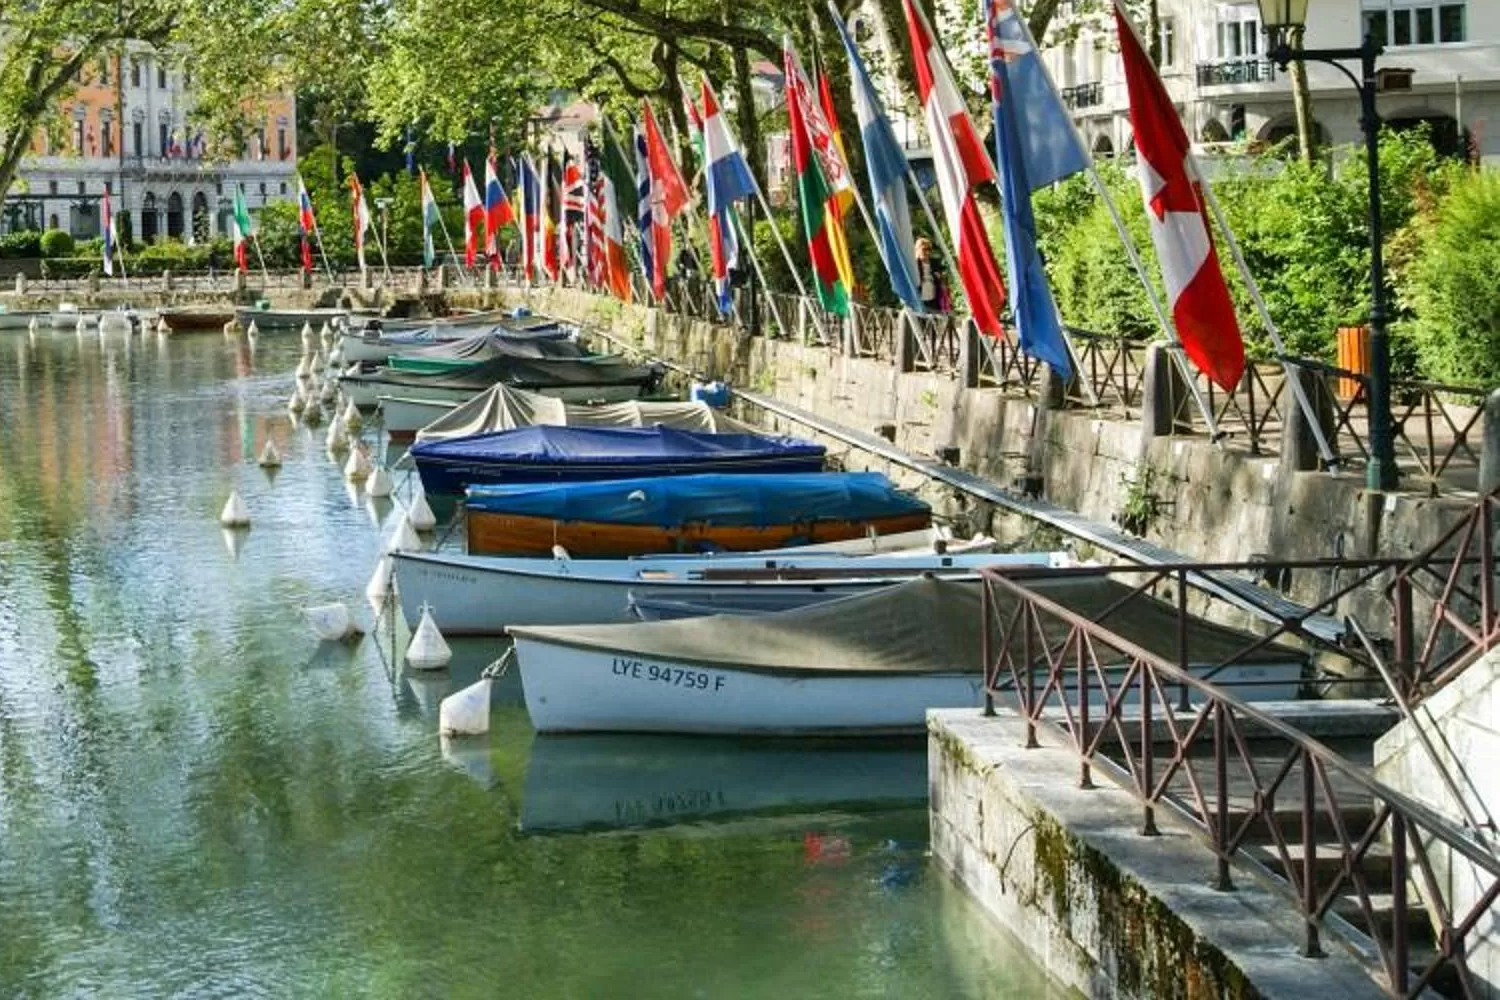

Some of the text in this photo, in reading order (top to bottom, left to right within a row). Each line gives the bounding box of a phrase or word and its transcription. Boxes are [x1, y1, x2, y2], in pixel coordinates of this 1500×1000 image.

[612, 657, 725, 692] LYE 94759 F
